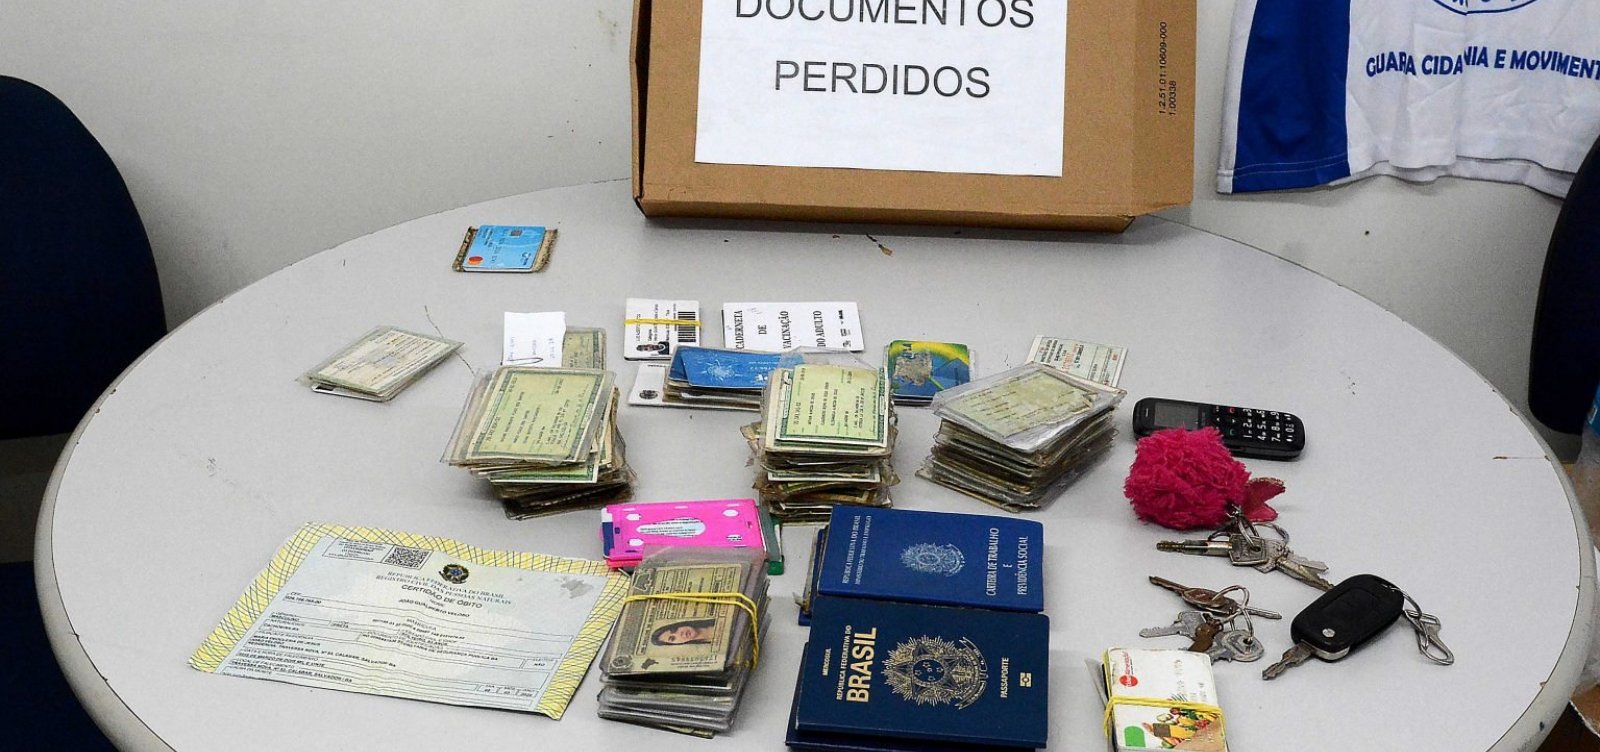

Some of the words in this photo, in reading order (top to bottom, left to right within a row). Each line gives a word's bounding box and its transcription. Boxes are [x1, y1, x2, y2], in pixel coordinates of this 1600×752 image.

[736, 0, 1034, 28] DOCUMENTOS
[1494, 49, 1506, 68] E
[775, 60, 990, 98] PERDIDOS
[1168, 80, 1176, 116] 1.00338
[734, 310, 744, 350] CADERNETA
[758, 324, 767, 335] DE
[778, 311, 792, 349] VACINAÇÃO
[812, 310, 825, 337] ADULTO
[816, 338, 826, 347] DO
[987, 528, 1000, 561] TRABALHO
[1018, 536, 1028, 558] SOCIAL
[986, 571, 998, 596] CARTEIRA
[1015, 560, 1028, 595] PREVIDÊNCIA
[401, 584, 442, 600] CERTIDÃO
[844, 625, 852, 634] DO
[822, 648, 832, 676] MERCOSUL
[840, 636, 850, 669] FEDERATIVA
[846, 627, 877, 702] BRASIL
[1000, 657, 1009, 698] PASSAPORTE
